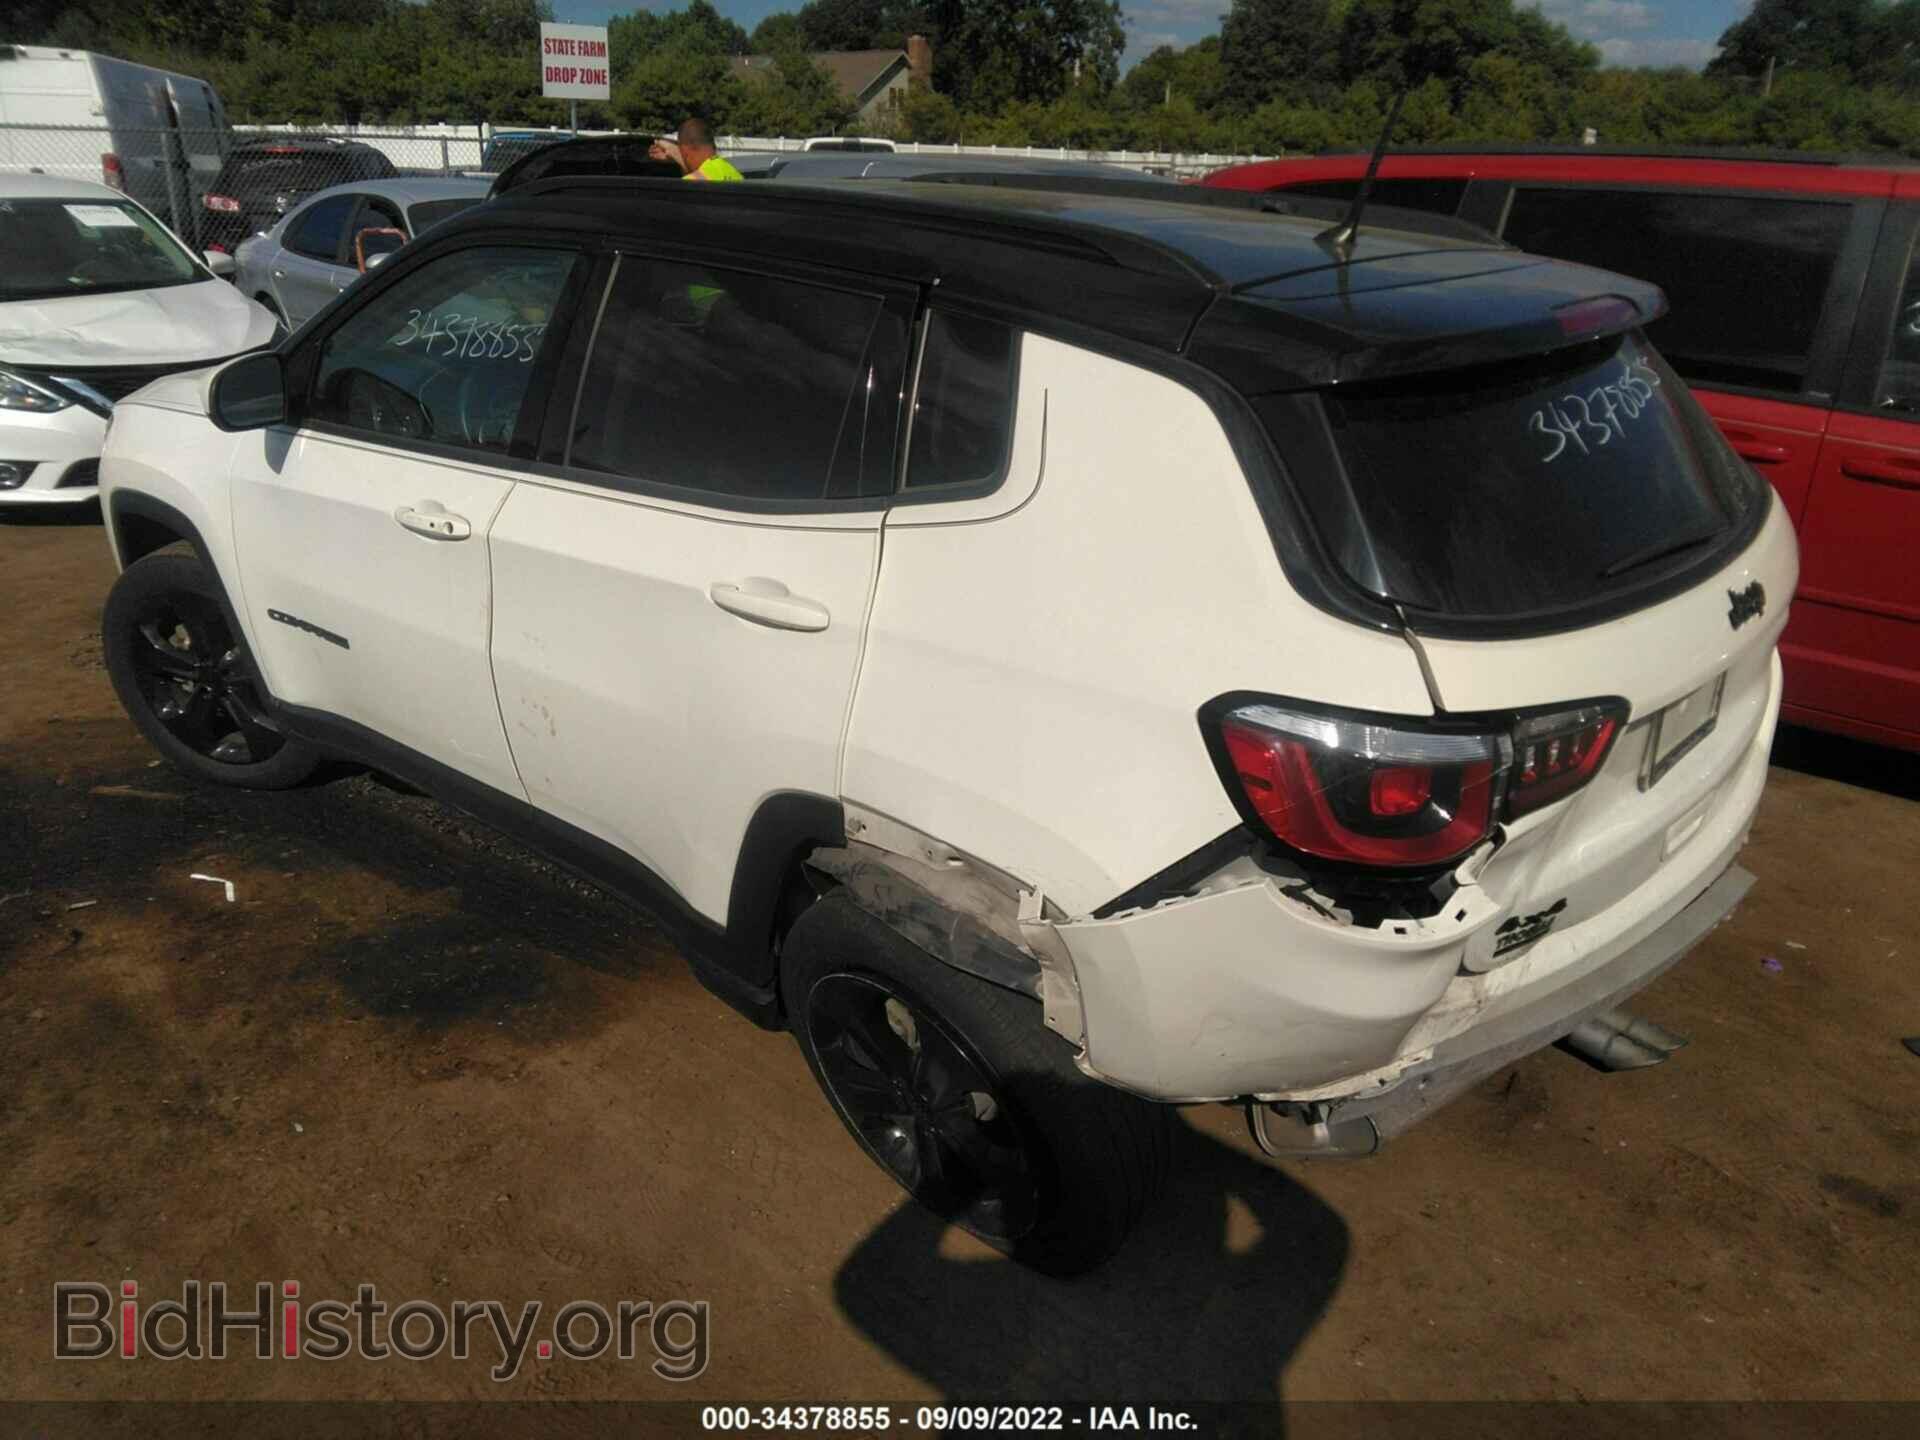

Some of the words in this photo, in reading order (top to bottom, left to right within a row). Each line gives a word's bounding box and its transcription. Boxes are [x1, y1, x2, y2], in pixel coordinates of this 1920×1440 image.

[544, 37, 576, 56] STATE
[578, 40, 607, 57] FARM
[545, 66, 577, 84] DROP
[579, 68, 608, 85] ZONE
